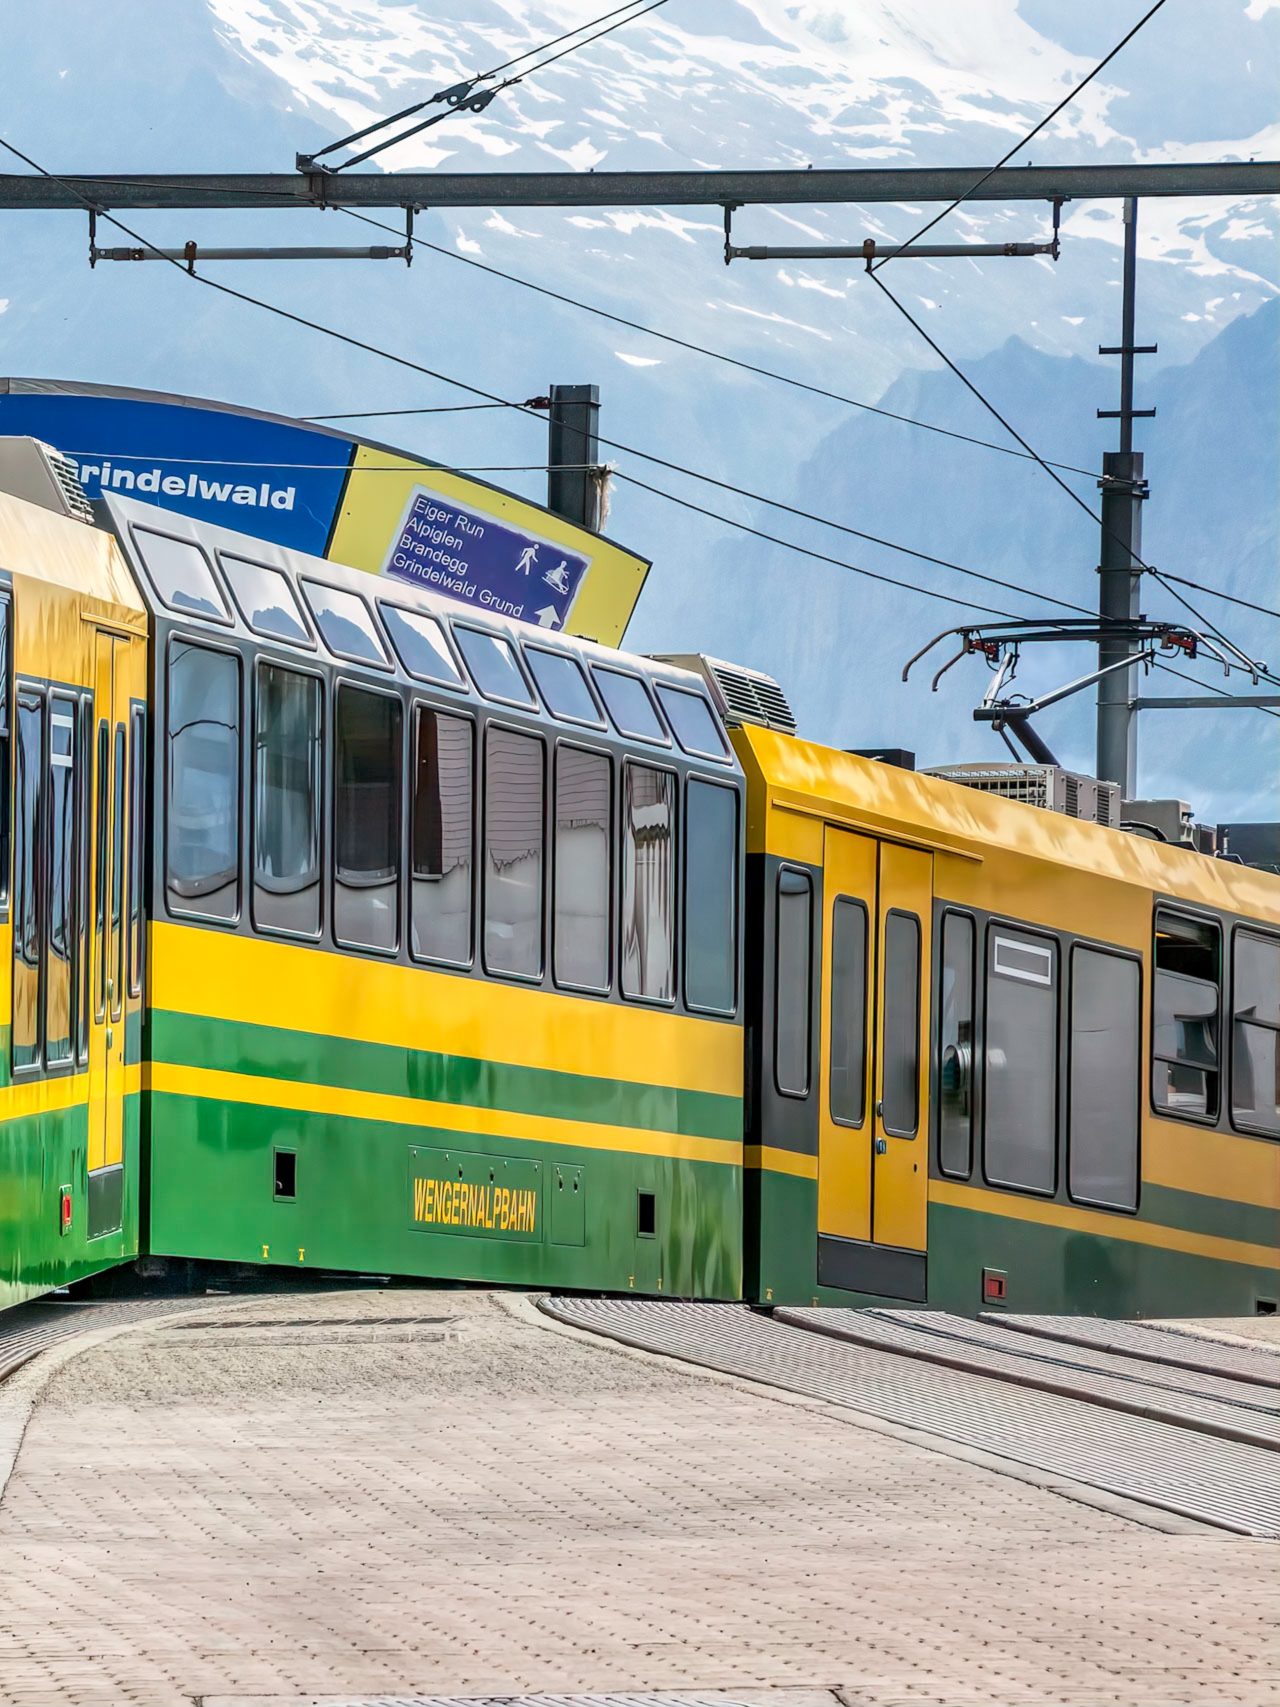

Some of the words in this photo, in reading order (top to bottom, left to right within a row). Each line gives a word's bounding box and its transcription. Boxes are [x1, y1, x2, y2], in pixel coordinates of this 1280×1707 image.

[406, 516, 463, 550] Alpiglen
[414, 497, 453, 521] Eiger
[454, 515, 485, 538] Run
[399, 534, 468, 576] Brandegg
[393, 553, 477, 597] Grindelwald
[479, 589, 524, 617] Grund
[414, 1178, 536, 1233] WENGERNALPBAHN
